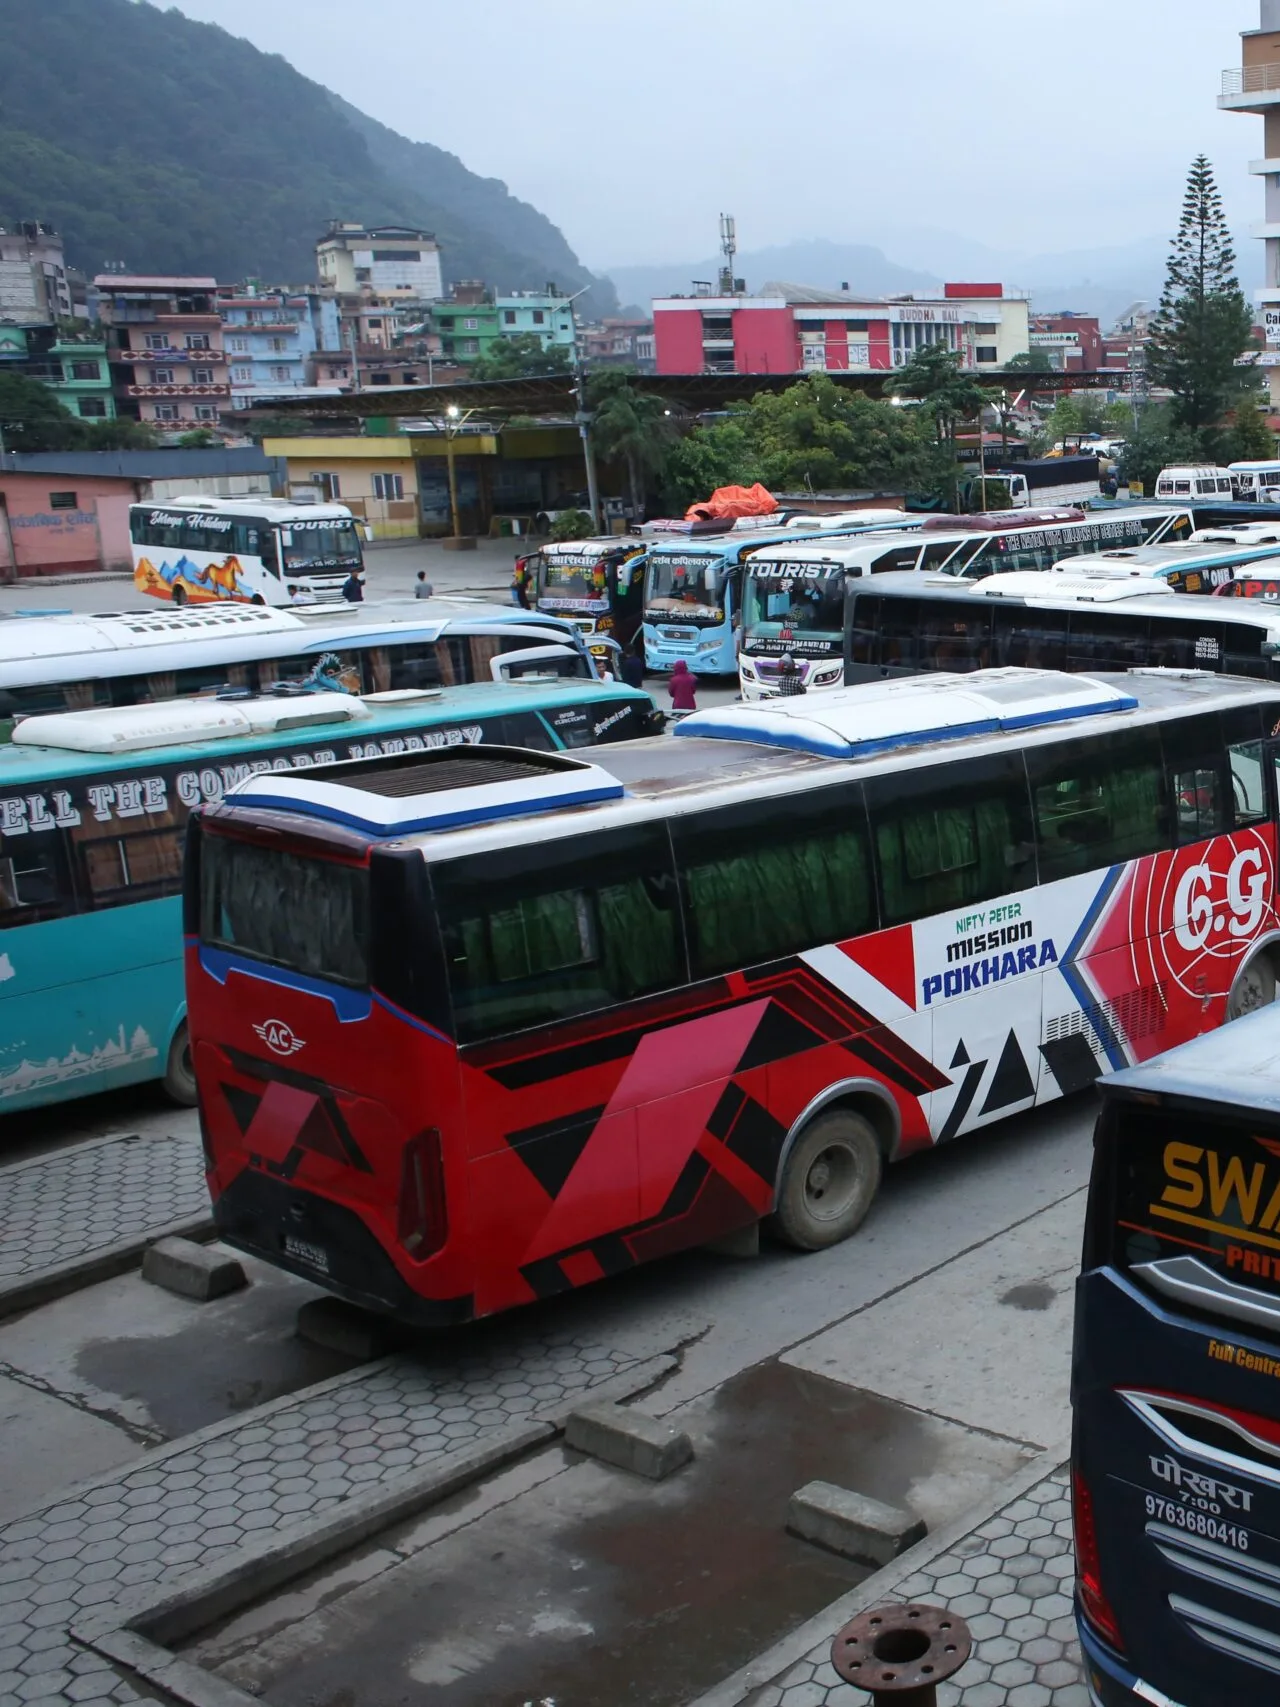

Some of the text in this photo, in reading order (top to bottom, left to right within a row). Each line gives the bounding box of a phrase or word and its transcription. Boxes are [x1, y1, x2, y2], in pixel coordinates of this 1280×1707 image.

[977, 447, 1013, 457] MATTES
[285, 519, 353, 532] TOURIST
[0, 724, 484, 836] ELL THE COMFORT JOURNEY
[956, 902, 1022, 936] NIFTY PETER
[922, 938, 1059, 1006] POKHARA
[1207, 1339, 1235, 1358] Full
[1149, 1454, 1254, 1512] पोखरा
[1178, 1489, 1221, 1515] 7:00
[1145, 1495, 1249, 1551] 9763680416
